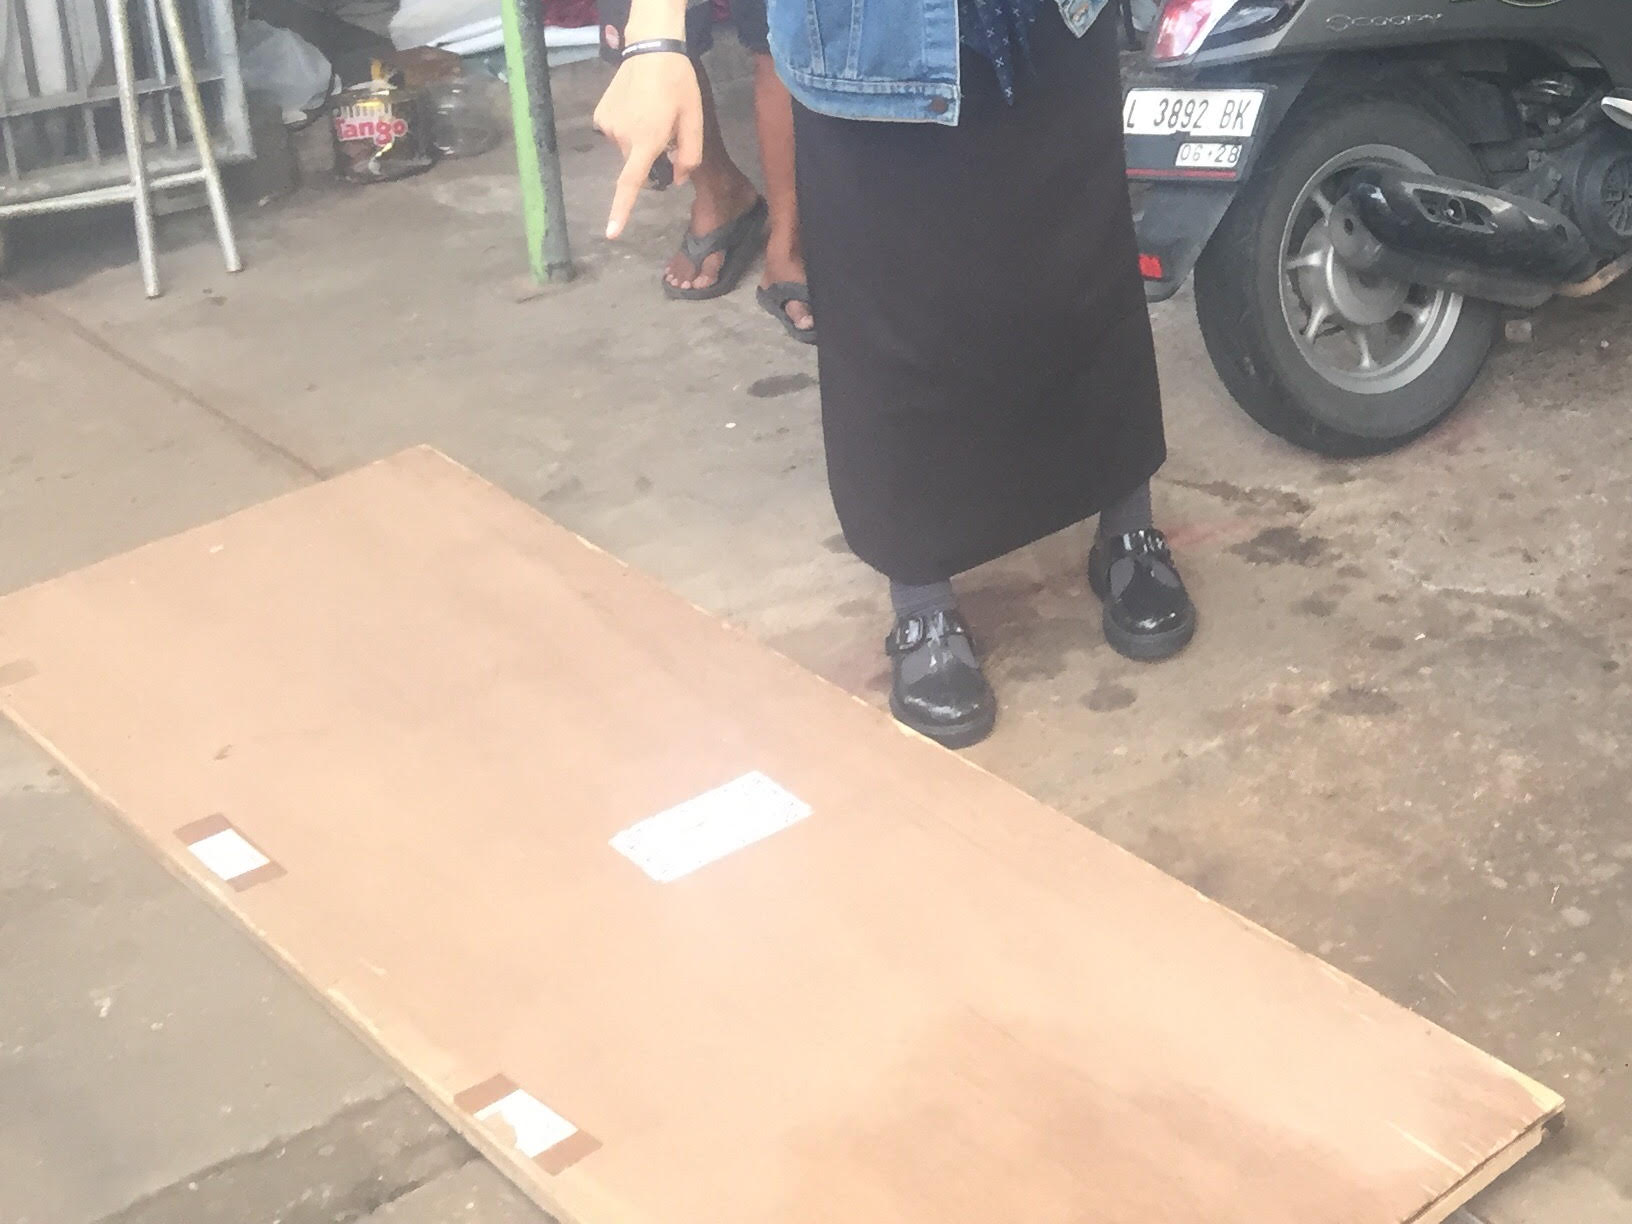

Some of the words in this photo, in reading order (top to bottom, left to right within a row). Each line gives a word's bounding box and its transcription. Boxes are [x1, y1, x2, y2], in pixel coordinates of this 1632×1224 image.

[1126, 99, 1137, 129] L
[1153, 97, 1209, 130] 3892
[1219, 99, 1252, 130] BK
